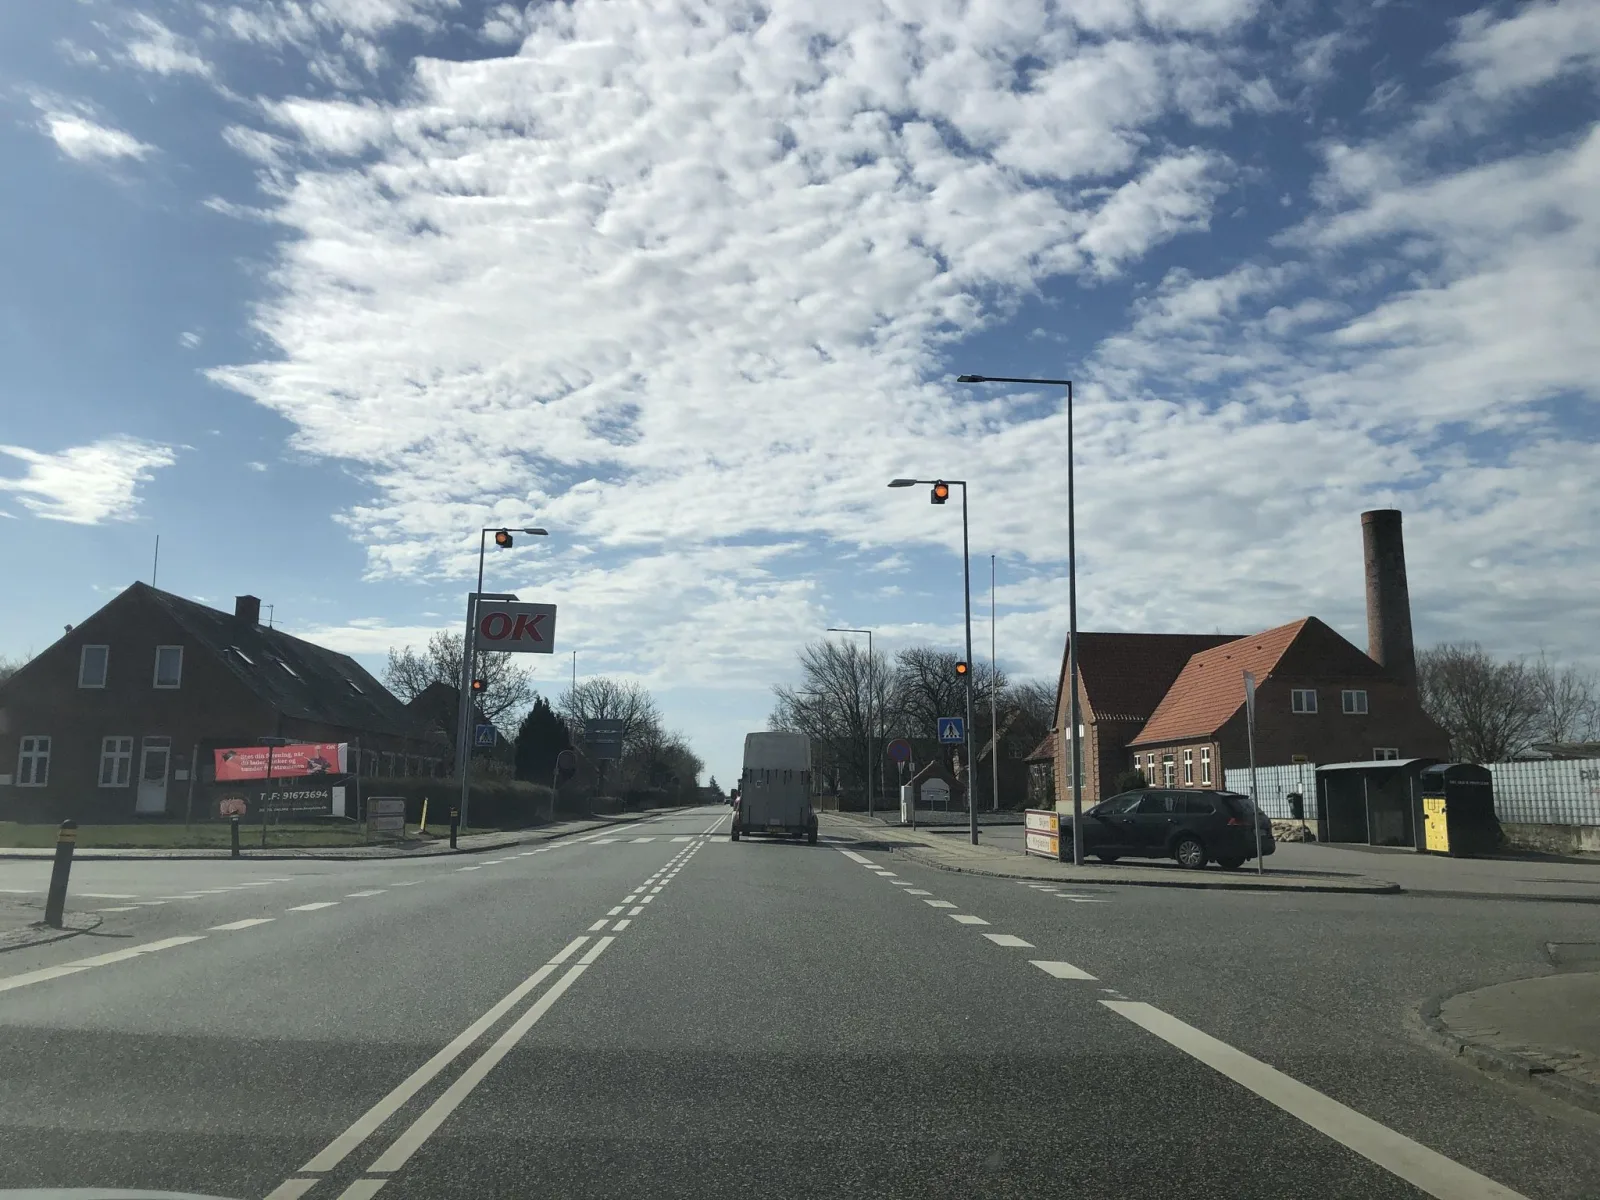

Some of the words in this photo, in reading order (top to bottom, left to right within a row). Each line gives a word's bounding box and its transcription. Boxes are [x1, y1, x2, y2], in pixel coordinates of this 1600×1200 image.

[480, 611, 548, 642] OK
[266, 751, 293, 759] frening,
[283, 791, 328, 800] 91673694
